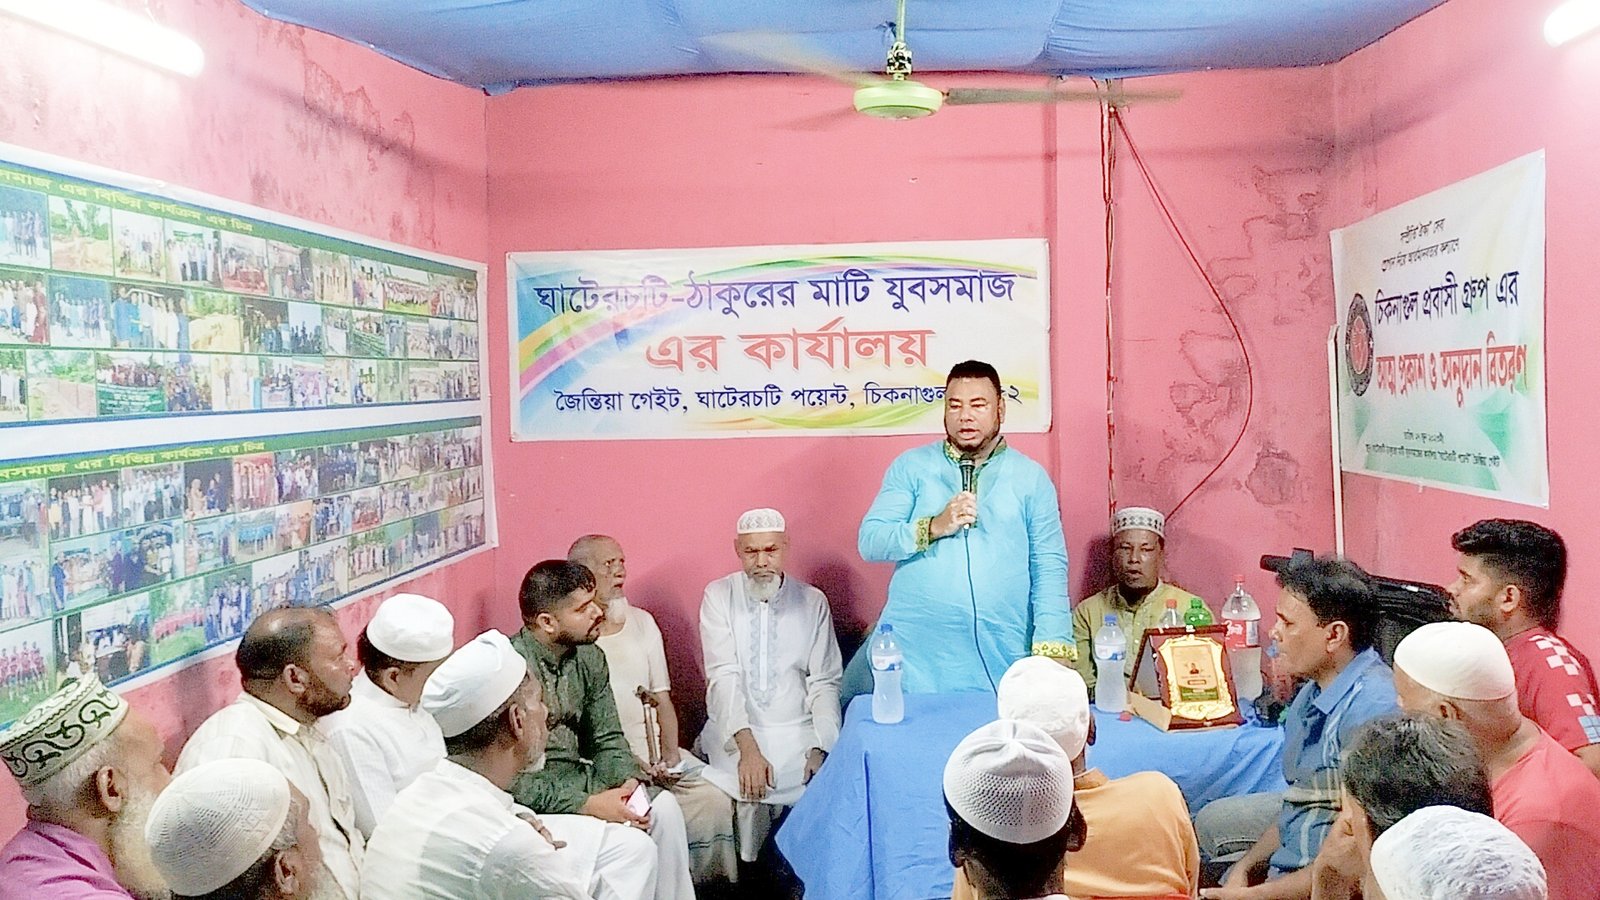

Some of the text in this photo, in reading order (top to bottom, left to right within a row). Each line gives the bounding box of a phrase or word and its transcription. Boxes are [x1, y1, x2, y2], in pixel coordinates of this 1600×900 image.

[59, 182, 89, 196] এর
[533, 269, 1018, 318] ঘাটেরচটি-ঠাকুরের মাটি যুবসমাজ
[1422, 271, 1458, 321] প্রবাসী
[1462, 273, 1490, 315] গ্রুপ
[1496, 271, 1519, 307] এর
[646, 316, 936, 373] এর কার্যালয়
[1430, 353, 1437, 391] ও
[1440, 348, 1482, 408] অনুদান
[1486, 330, 1528, 394] বিতরণ
[629, 384, 688, 414] গেইট,
[695, 384, 784, 409] ঘাটেরচটি
[790, 381, 856, 410] পয়েন্ট,
[75, 458, 104, 471] এর
